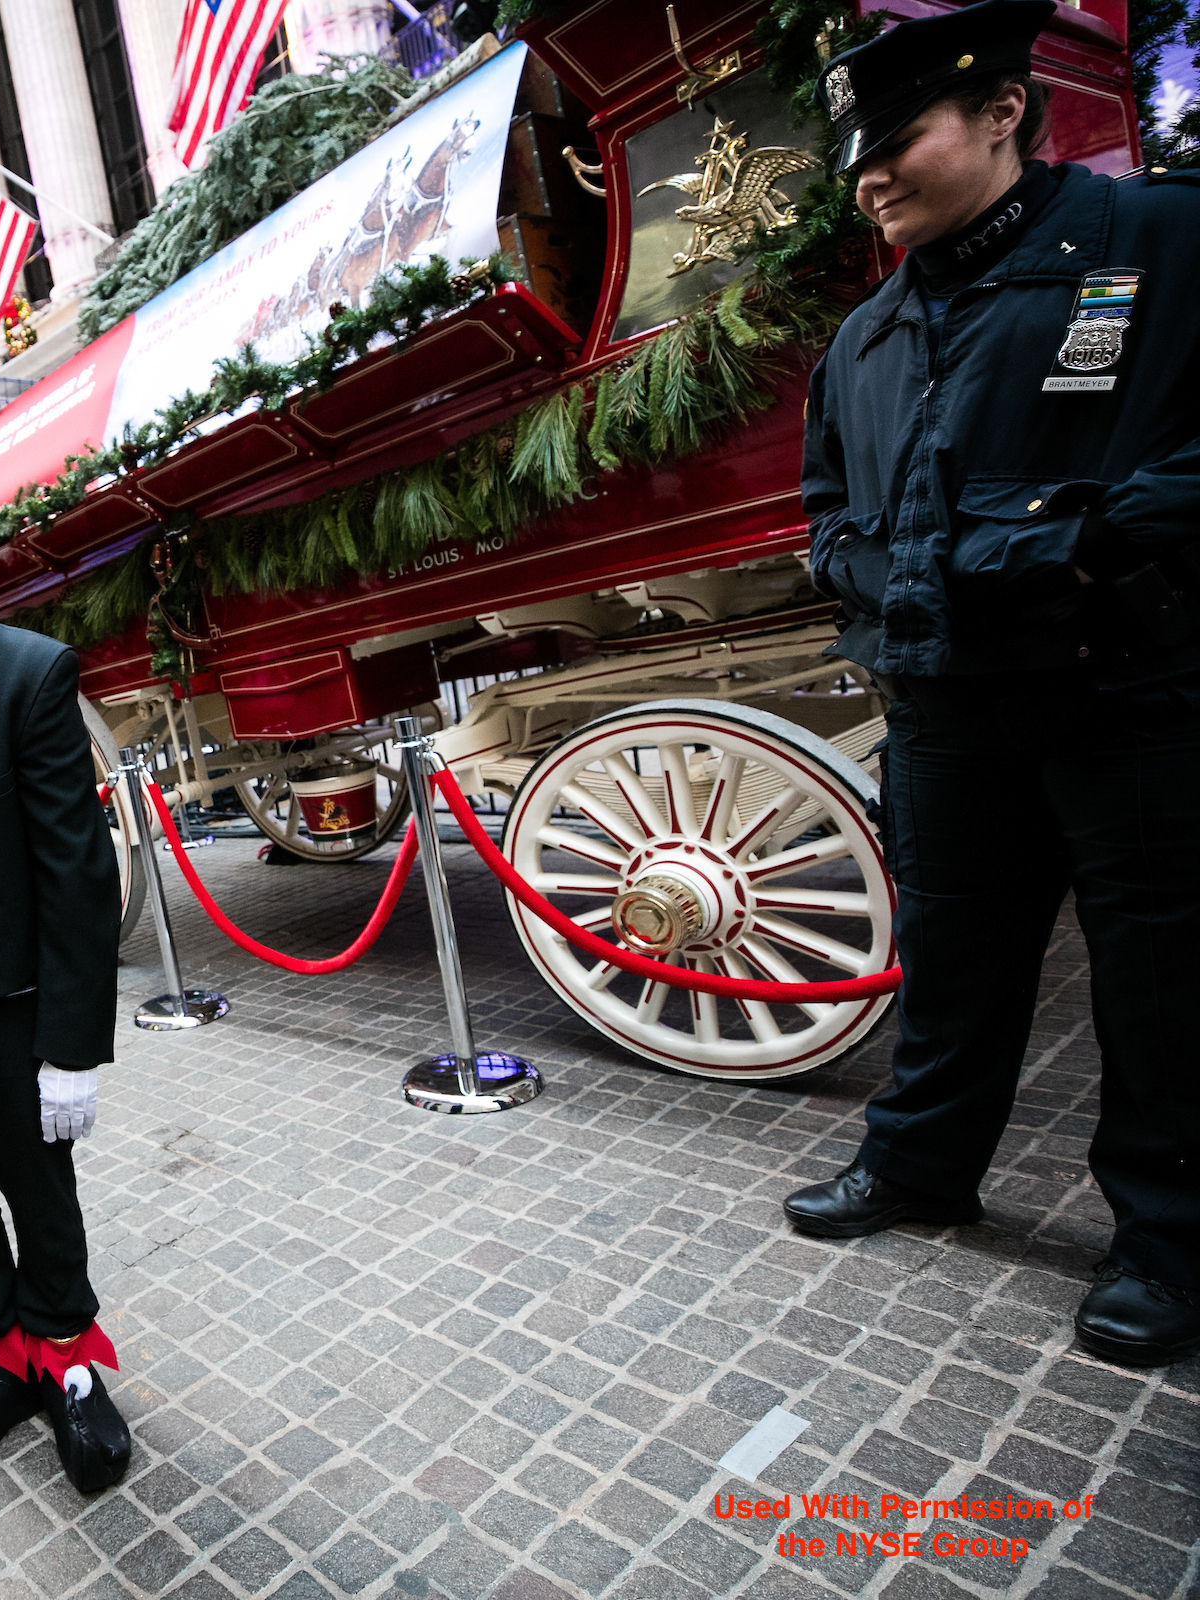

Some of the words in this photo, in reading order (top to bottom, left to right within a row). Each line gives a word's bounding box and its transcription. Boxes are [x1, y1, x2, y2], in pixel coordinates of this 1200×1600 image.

[953, 202, 1023, 260] NYPD
[208, 252, 256, 294] FAMILY
[259, 238, 277, 259] TO
[1068, 348, 1112, 366] 19186
[1048, 379, 1109, 388] BRANTMEYER
